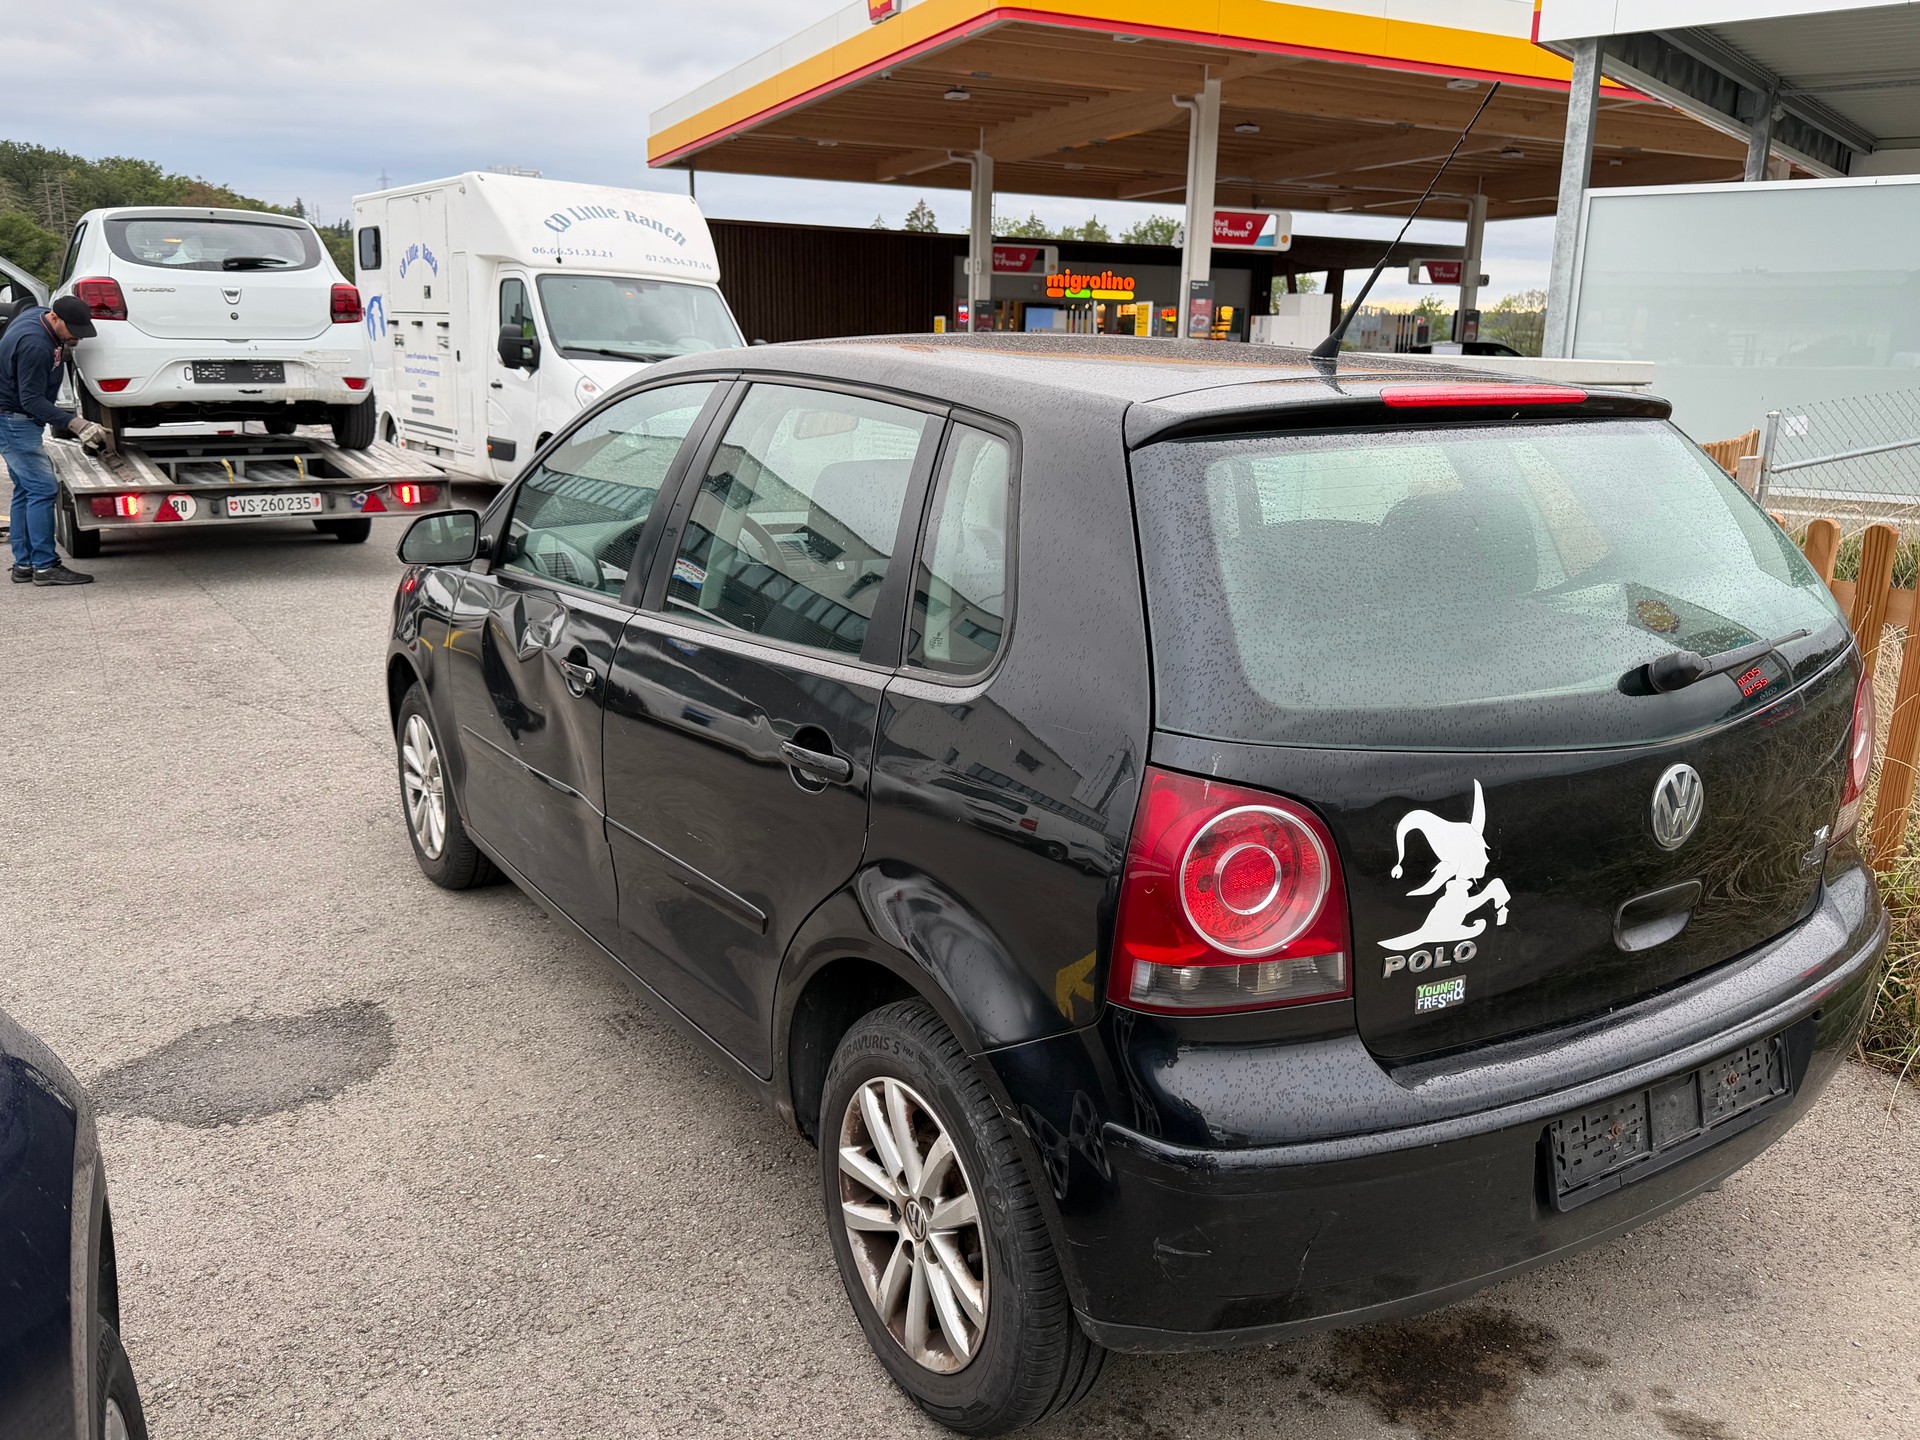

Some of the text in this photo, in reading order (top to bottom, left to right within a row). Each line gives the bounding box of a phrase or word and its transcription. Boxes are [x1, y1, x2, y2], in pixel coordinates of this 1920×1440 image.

[543, 205, 688, 247] CD Little Ranch
[1214, 219, 1229, 228] Shell
[1214, 226, 1250, 238] V-Power
[1046, 268, 1135, 294] migrolino
[173, 500, 188, 512] 80
[1382, 940, 1478, 979] POLO
[1417, 981, 1455, 997] YOUNG
[1417, 990, 1454, 1010] FRESH
[841, 1034, 890, 1061] BRAVURIS
[892, 1040, 901, 1055] 5
